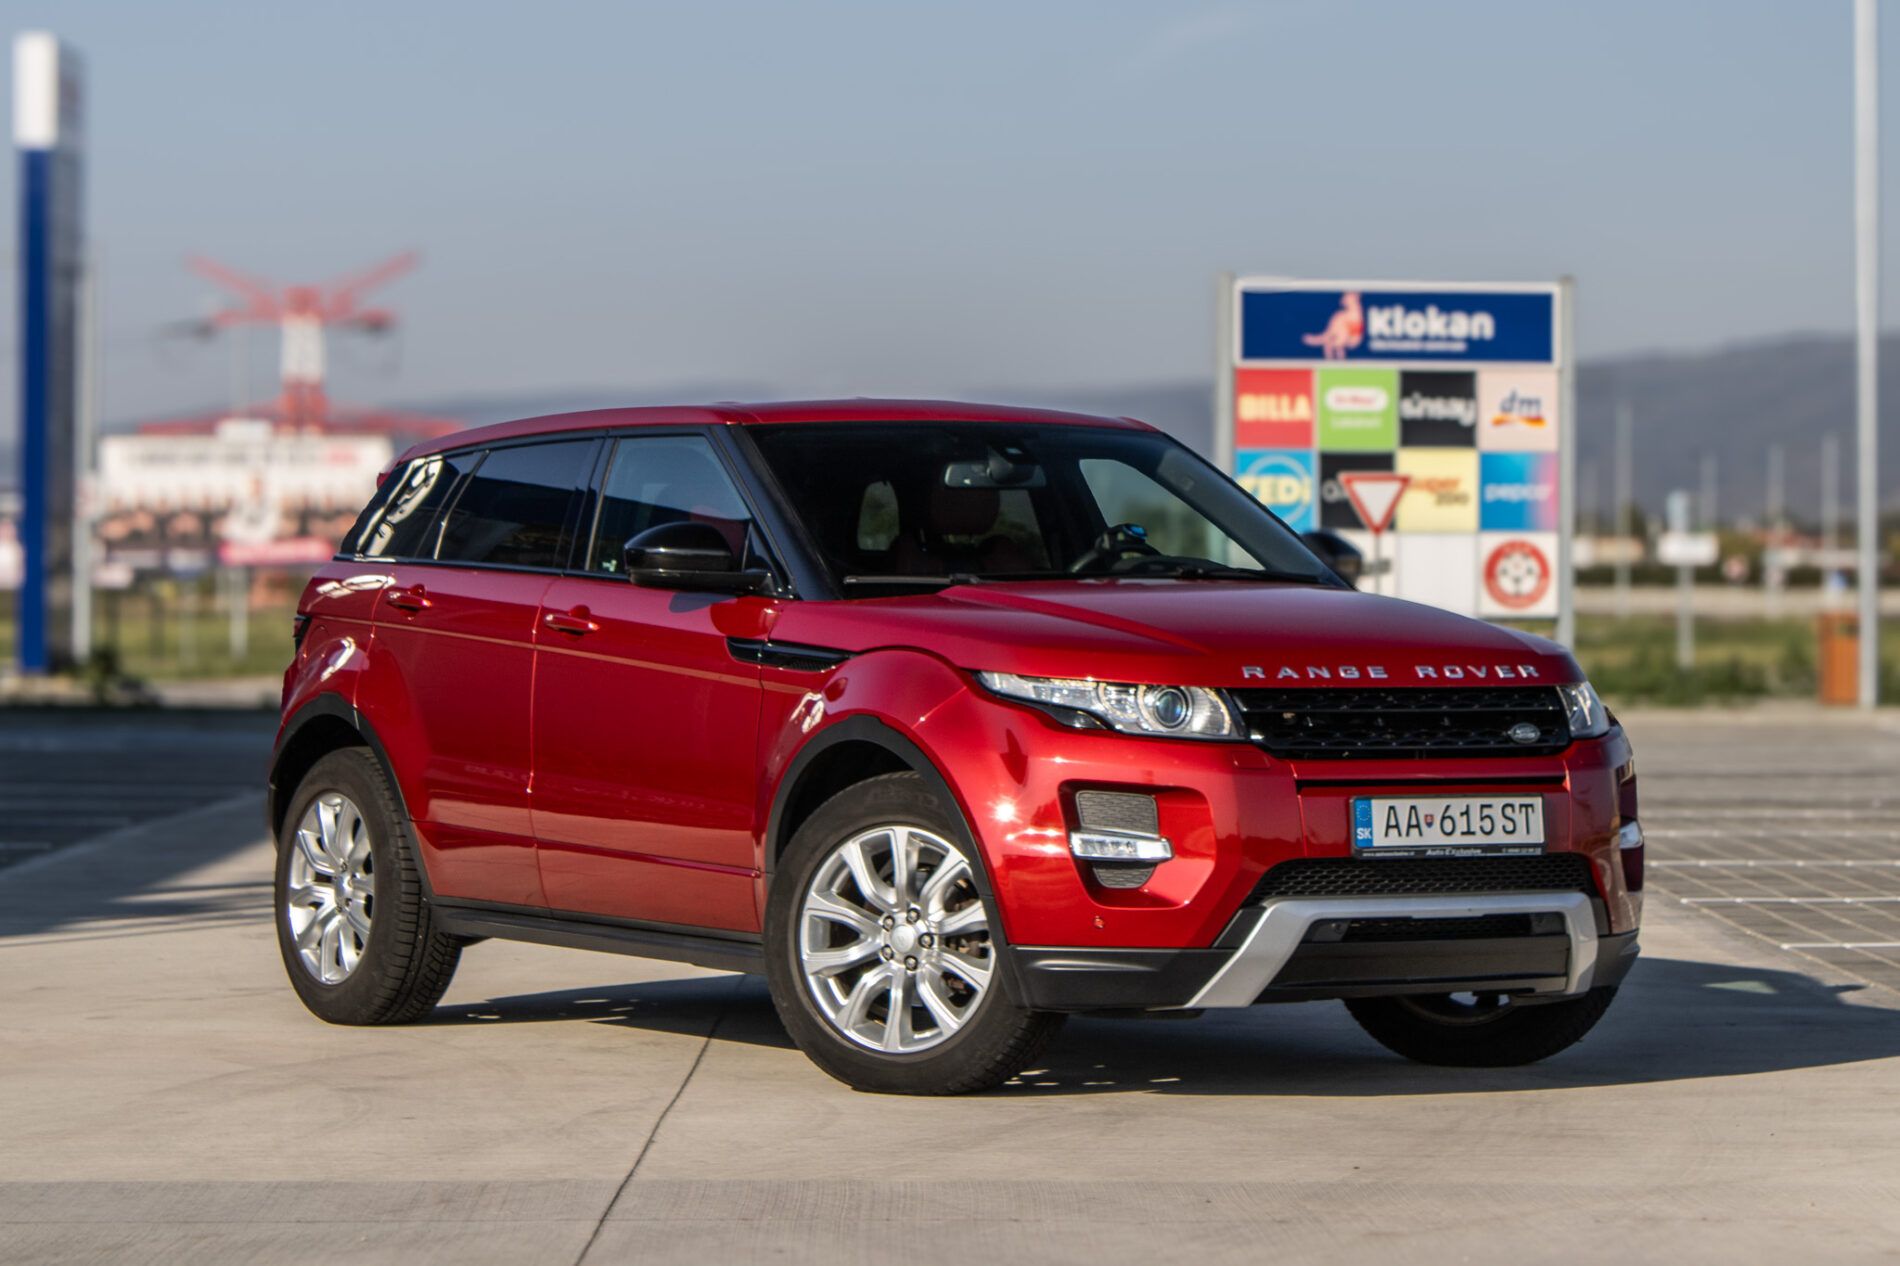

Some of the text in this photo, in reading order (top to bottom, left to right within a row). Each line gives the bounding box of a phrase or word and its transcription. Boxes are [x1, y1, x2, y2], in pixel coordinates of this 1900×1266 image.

[1368, 305, 1495, 340] Klokan
[1239, 394, 1312, 421] BILLA
[1401, 391, 1476, 427] sinsay
[1500, 389, 1541, 414] dm
[1242, 664, 1540, 679] RANGE ROVER
[1356, 828, 1373, 840] SK
